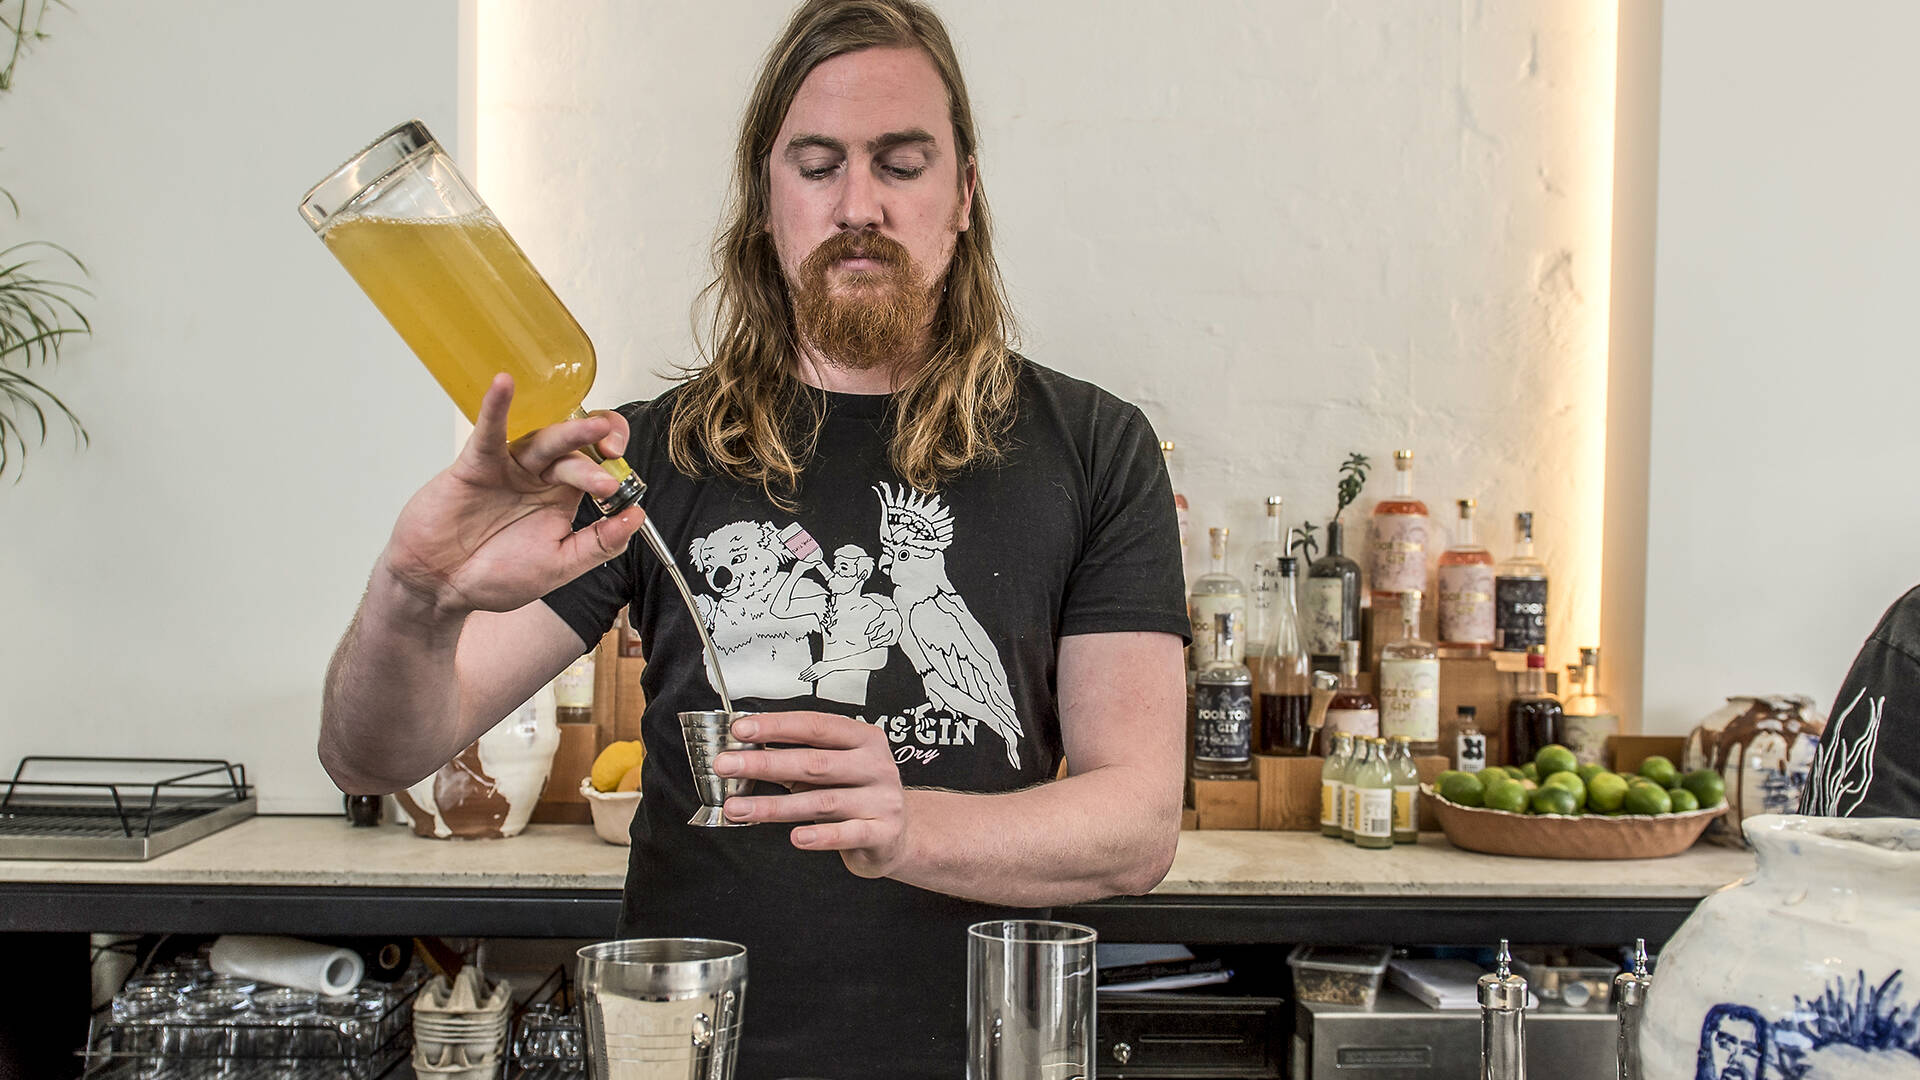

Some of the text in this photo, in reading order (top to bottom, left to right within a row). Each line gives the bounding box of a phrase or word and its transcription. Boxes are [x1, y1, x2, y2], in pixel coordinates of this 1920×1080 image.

[915, 717, 978, 746] GIN
[1217, 722, 1239, 733] GIN
[894, 745, 940, 764] Dry
